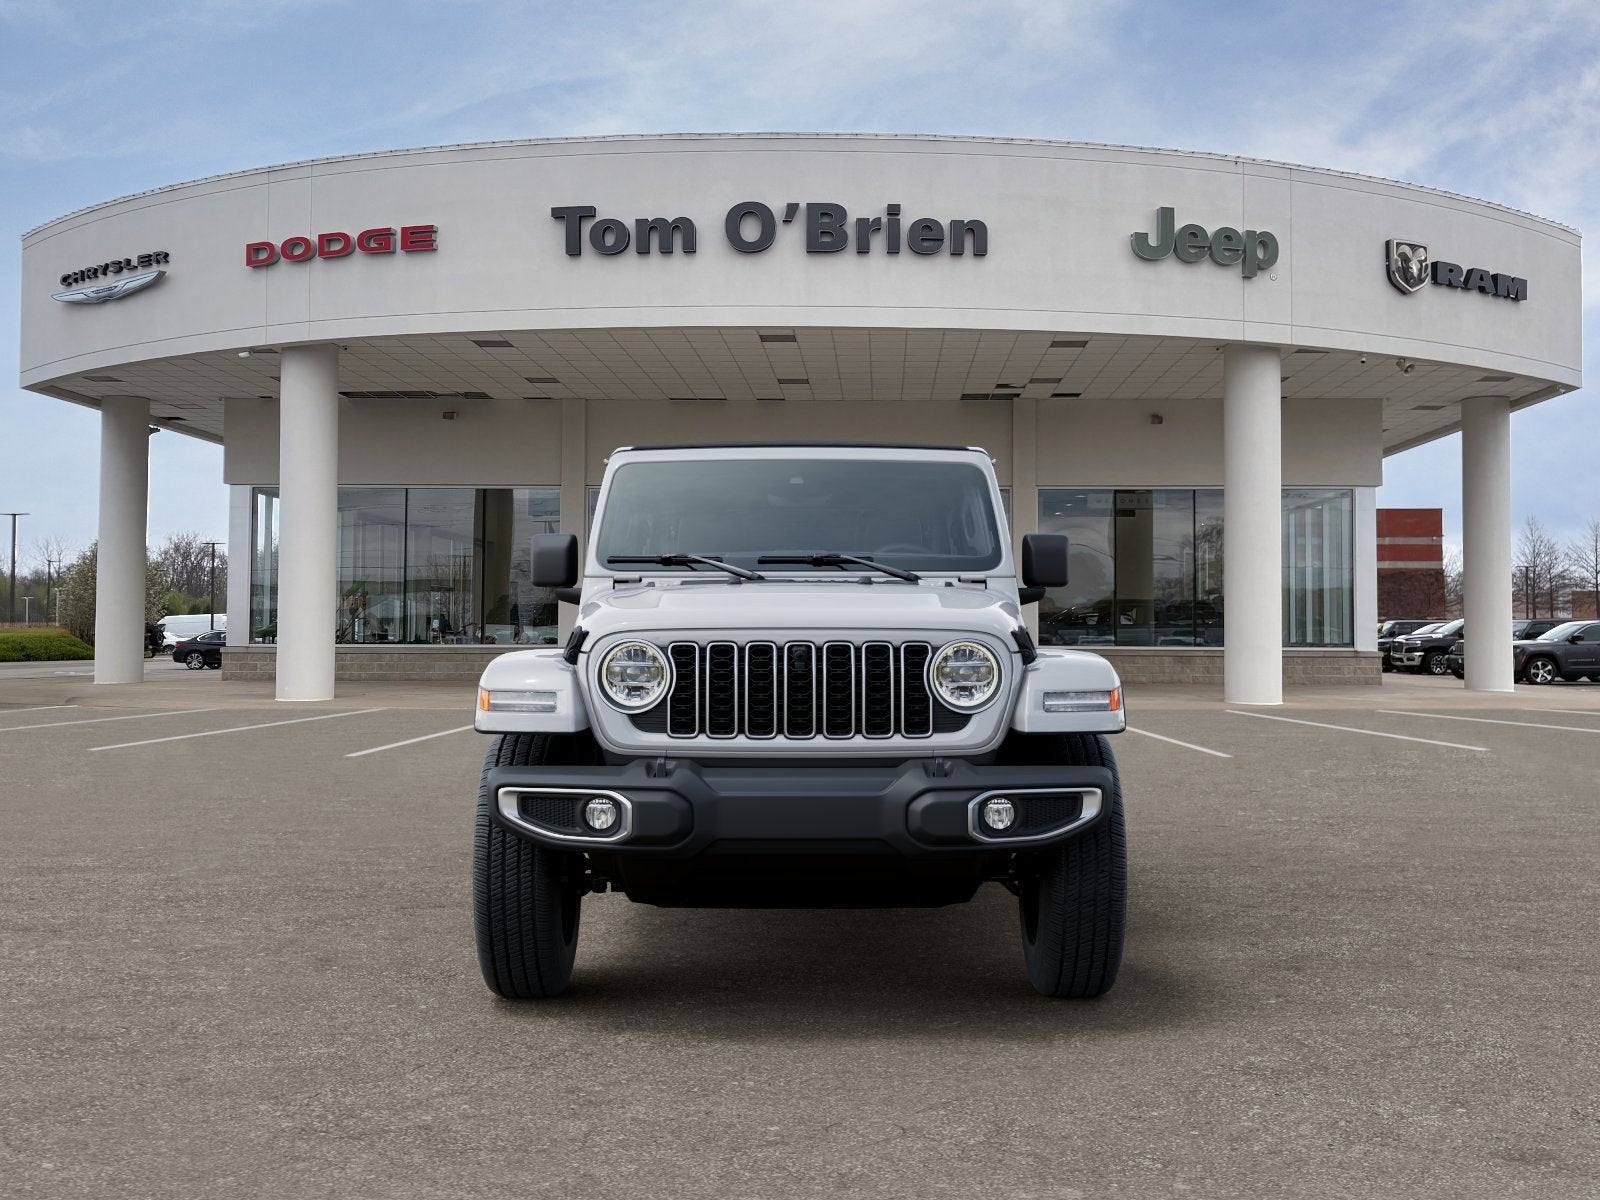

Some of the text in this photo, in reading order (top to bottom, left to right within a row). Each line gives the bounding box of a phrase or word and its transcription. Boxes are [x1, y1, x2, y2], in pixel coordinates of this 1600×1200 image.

[245, 224, 438, 268] DODGE
[551, 201, 988, 257] Tom O'Brien
[1131, 207, 1279, 278] Jeep
[60, 250, 170, 287] CHRYSLER
[1431, 260, 1527, 301] RAM
